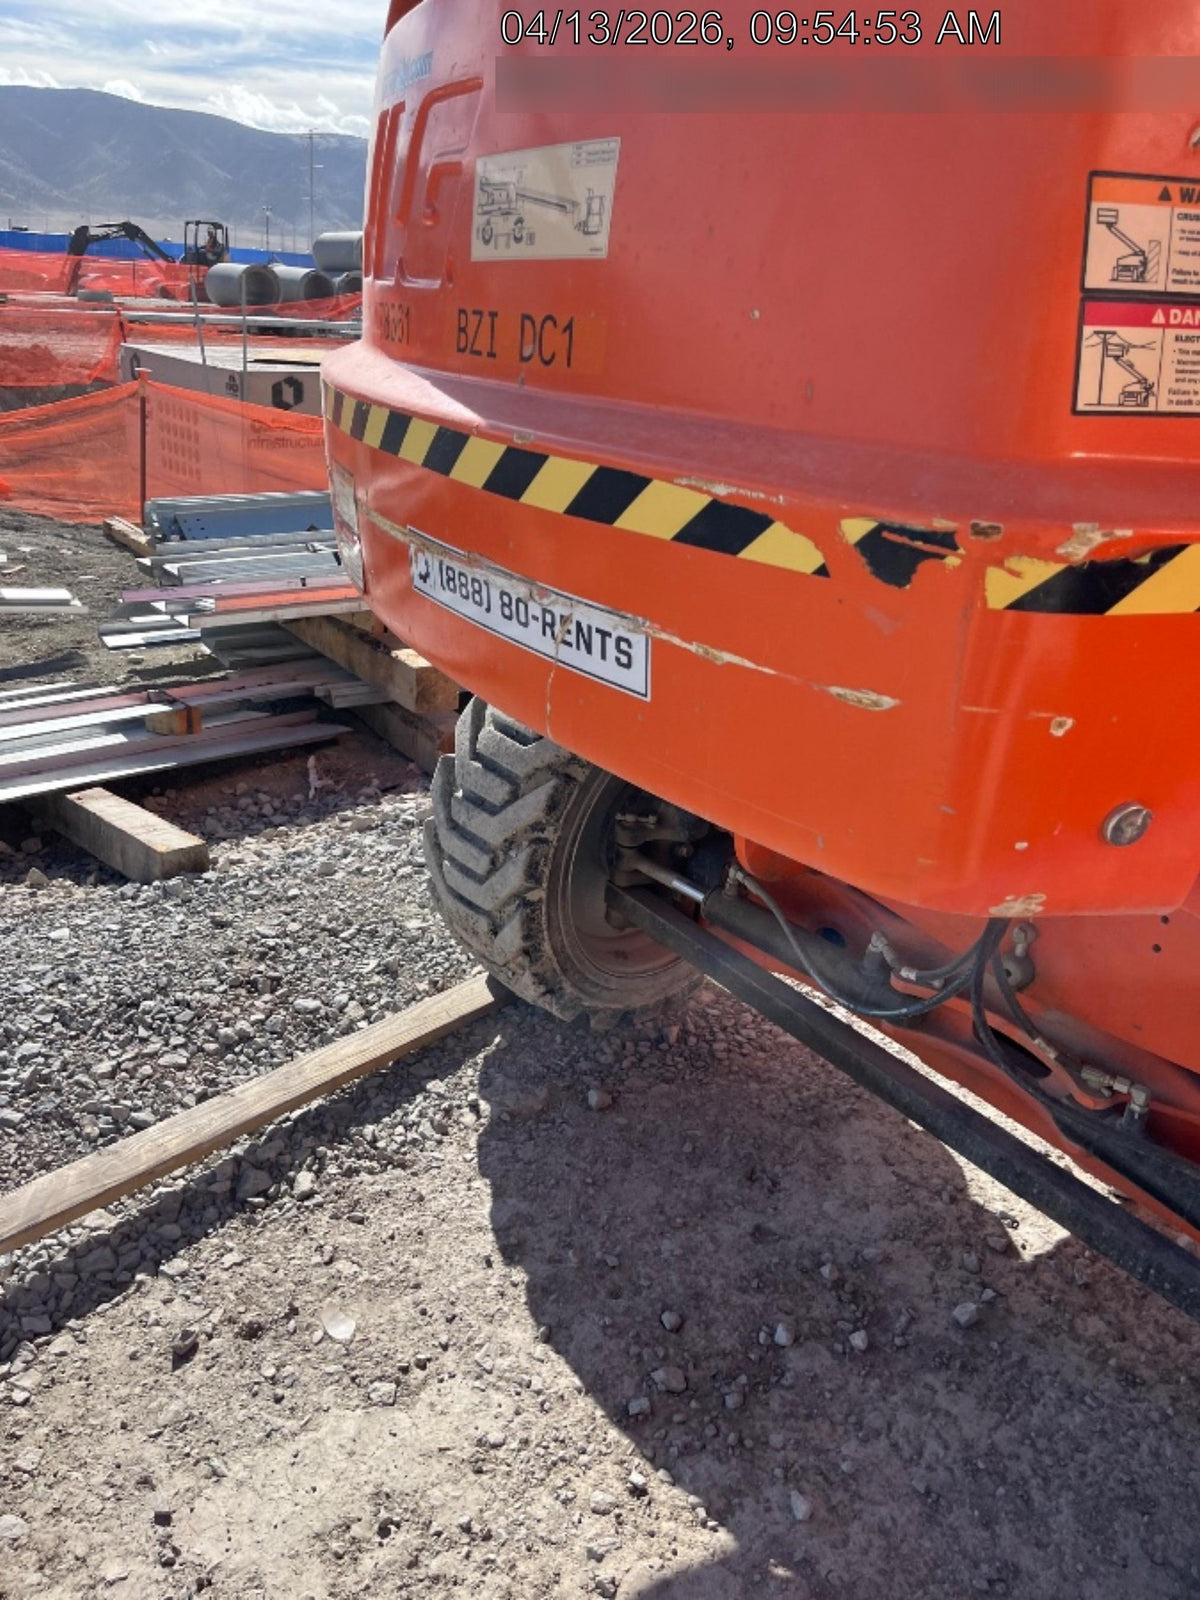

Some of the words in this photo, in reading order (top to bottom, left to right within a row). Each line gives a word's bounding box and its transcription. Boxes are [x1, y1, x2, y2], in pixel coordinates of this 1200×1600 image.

[456, 308, 499, 359] BZI
[519, 312, 575, 368] DC1
[438, 559, 491, 614] (888)
[499, 589, 633, 671] 80-RENTS
